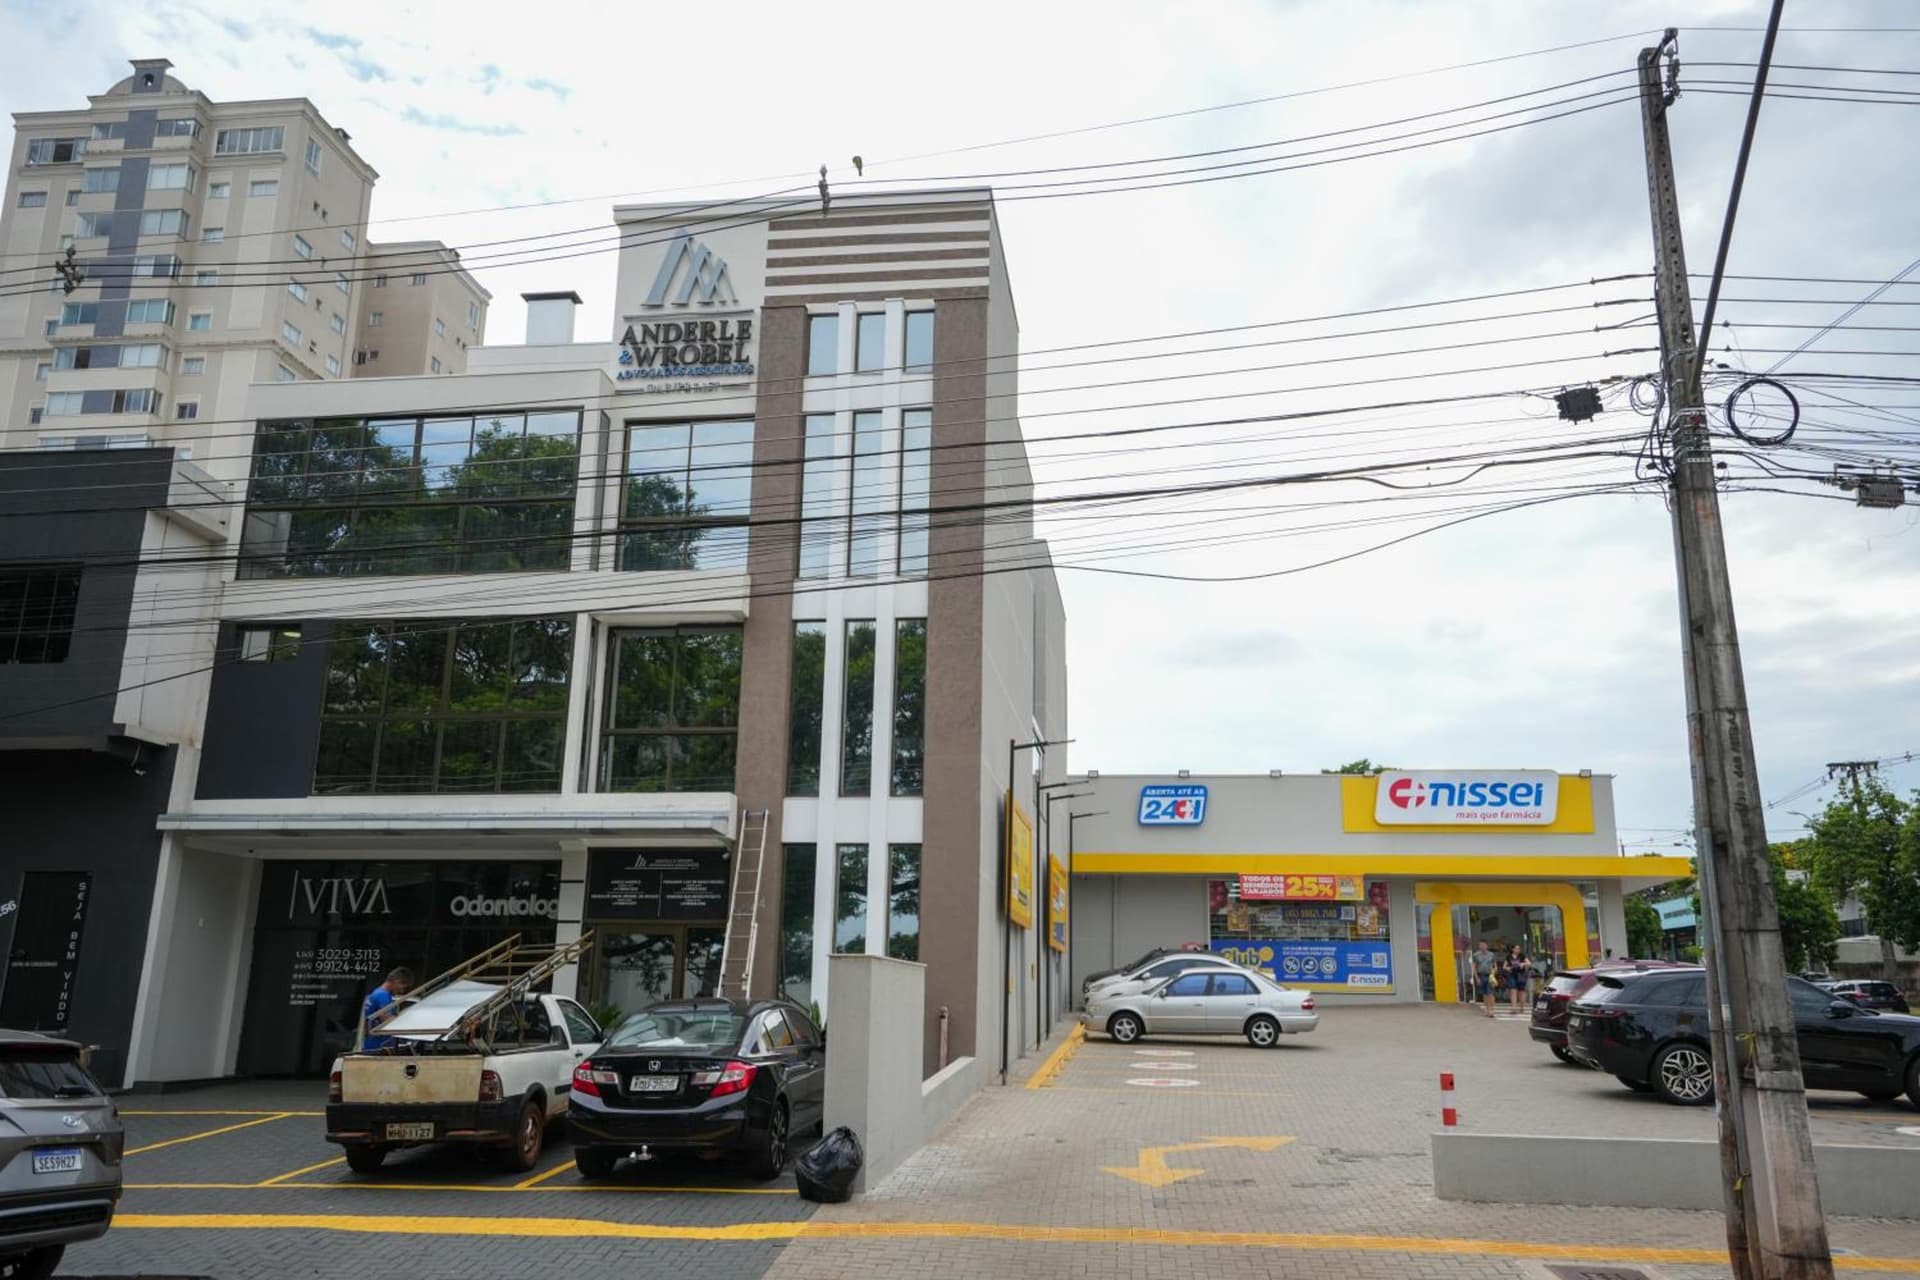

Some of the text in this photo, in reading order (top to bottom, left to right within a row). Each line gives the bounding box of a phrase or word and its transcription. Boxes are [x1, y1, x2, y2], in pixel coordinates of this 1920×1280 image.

[619, 320, 752, 346] ANDERLE
[619, 342, 750, 367] & WROBEL
[1429, 780, 1544, 808] nissei
[1456, 809, 1542, 821] mais que farmácia
[303, 878, 392, 914] VIVA
[1286, 876, 1334, 897] 25%
[73, 882, 87, 920] SEJA
[66, 931, 79, 960] BEM
[316, 949, 380, 960] 3029-3113
[315, 960, 380, 972] 99124-4412
[56, 971, 73, 1021] VINDO
